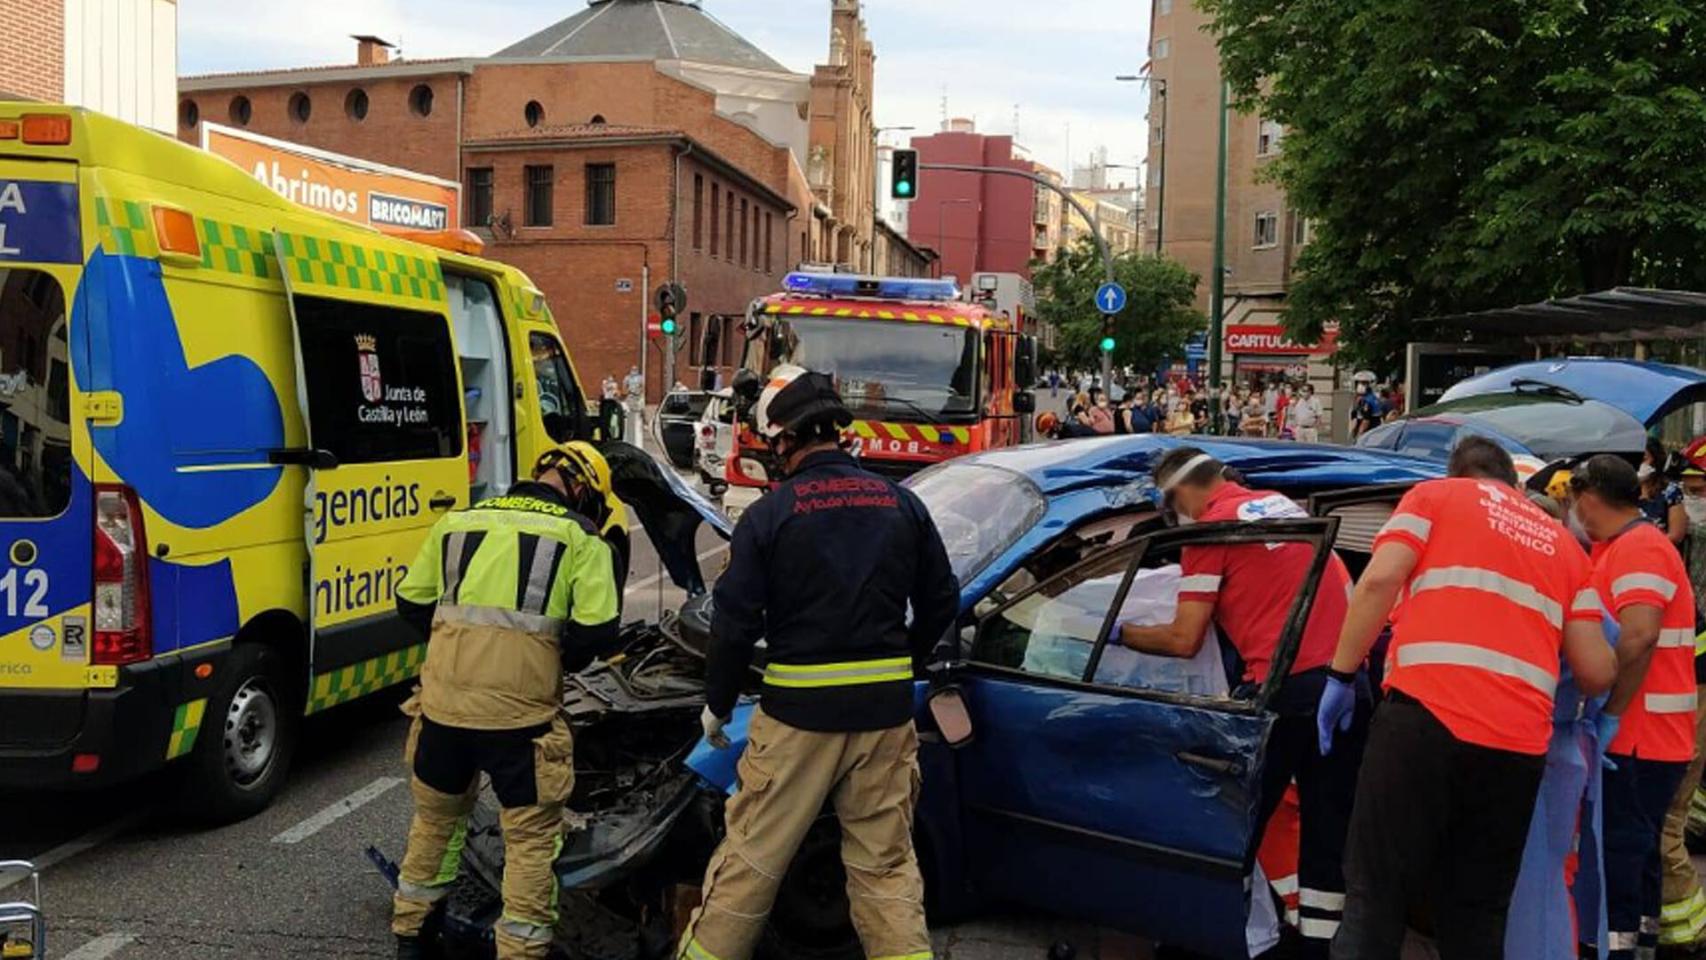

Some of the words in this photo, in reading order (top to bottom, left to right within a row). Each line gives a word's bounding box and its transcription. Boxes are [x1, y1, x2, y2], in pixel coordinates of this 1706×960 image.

[253, 160, 358, 214] Abrimos
[371, 198, 445, 229] BRICOMART
[1228, 334, 1318, 350] CARTUC
[385, 384, 412, 401] Junta
[413, 386, 426, 402] de
[358, 405, 395, 422] Castilla
